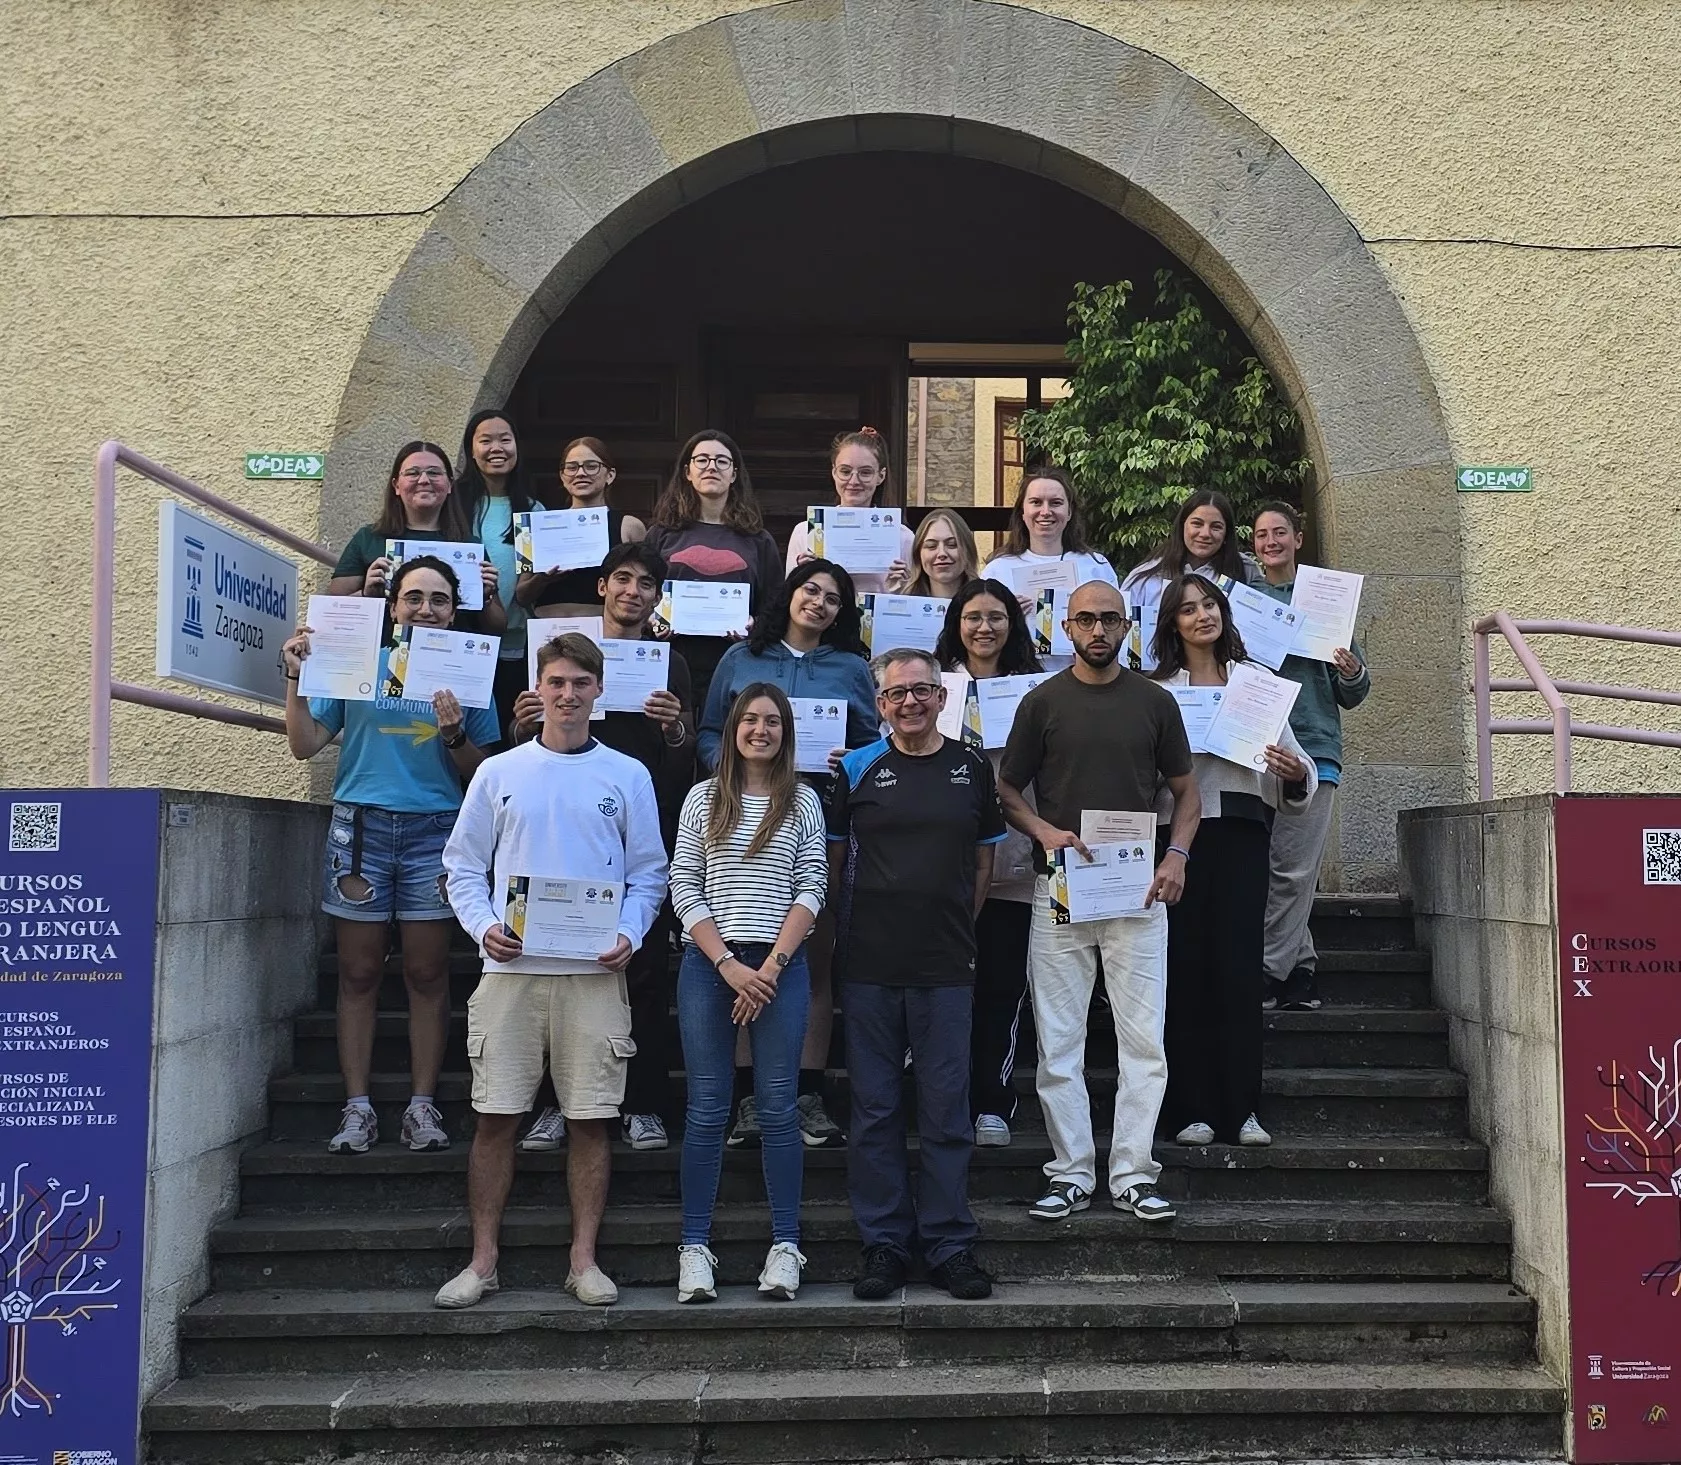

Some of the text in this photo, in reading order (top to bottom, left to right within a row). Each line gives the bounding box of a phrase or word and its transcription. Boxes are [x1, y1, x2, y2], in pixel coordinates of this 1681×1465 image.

[270, 457, 307, 473] DEA
[1473, 471, 1509, 486] DEA
[214, 552, 287, 621] Universidad
[215, 604, 264, 652] Zaragoza
[0, 874, 83, 896] URSOS
[0, 895, 110, 914] ESPAÑOL
[20, 919, 122, 938] LENGUA
[1572, 956, 1681, 974] EXTRAOR
[31, 971, 49, 982] de
[52, 970, 123, 983] Zaragoza
[0, 1011, 59, 1023] CURSOS
[3, 1024, 77, 1037] ESPAÑOL
[0, 1073, 69, 1085] RSOS DE
[0, 1086, 106, 1099] CIÓN INICIAL
[0, 1100, 95, 1113] ECIALIZADA
[0, 1114, 118, 1127] ESORES DE ELE
[69, 1450, 112, 1459] GOBIERNO
